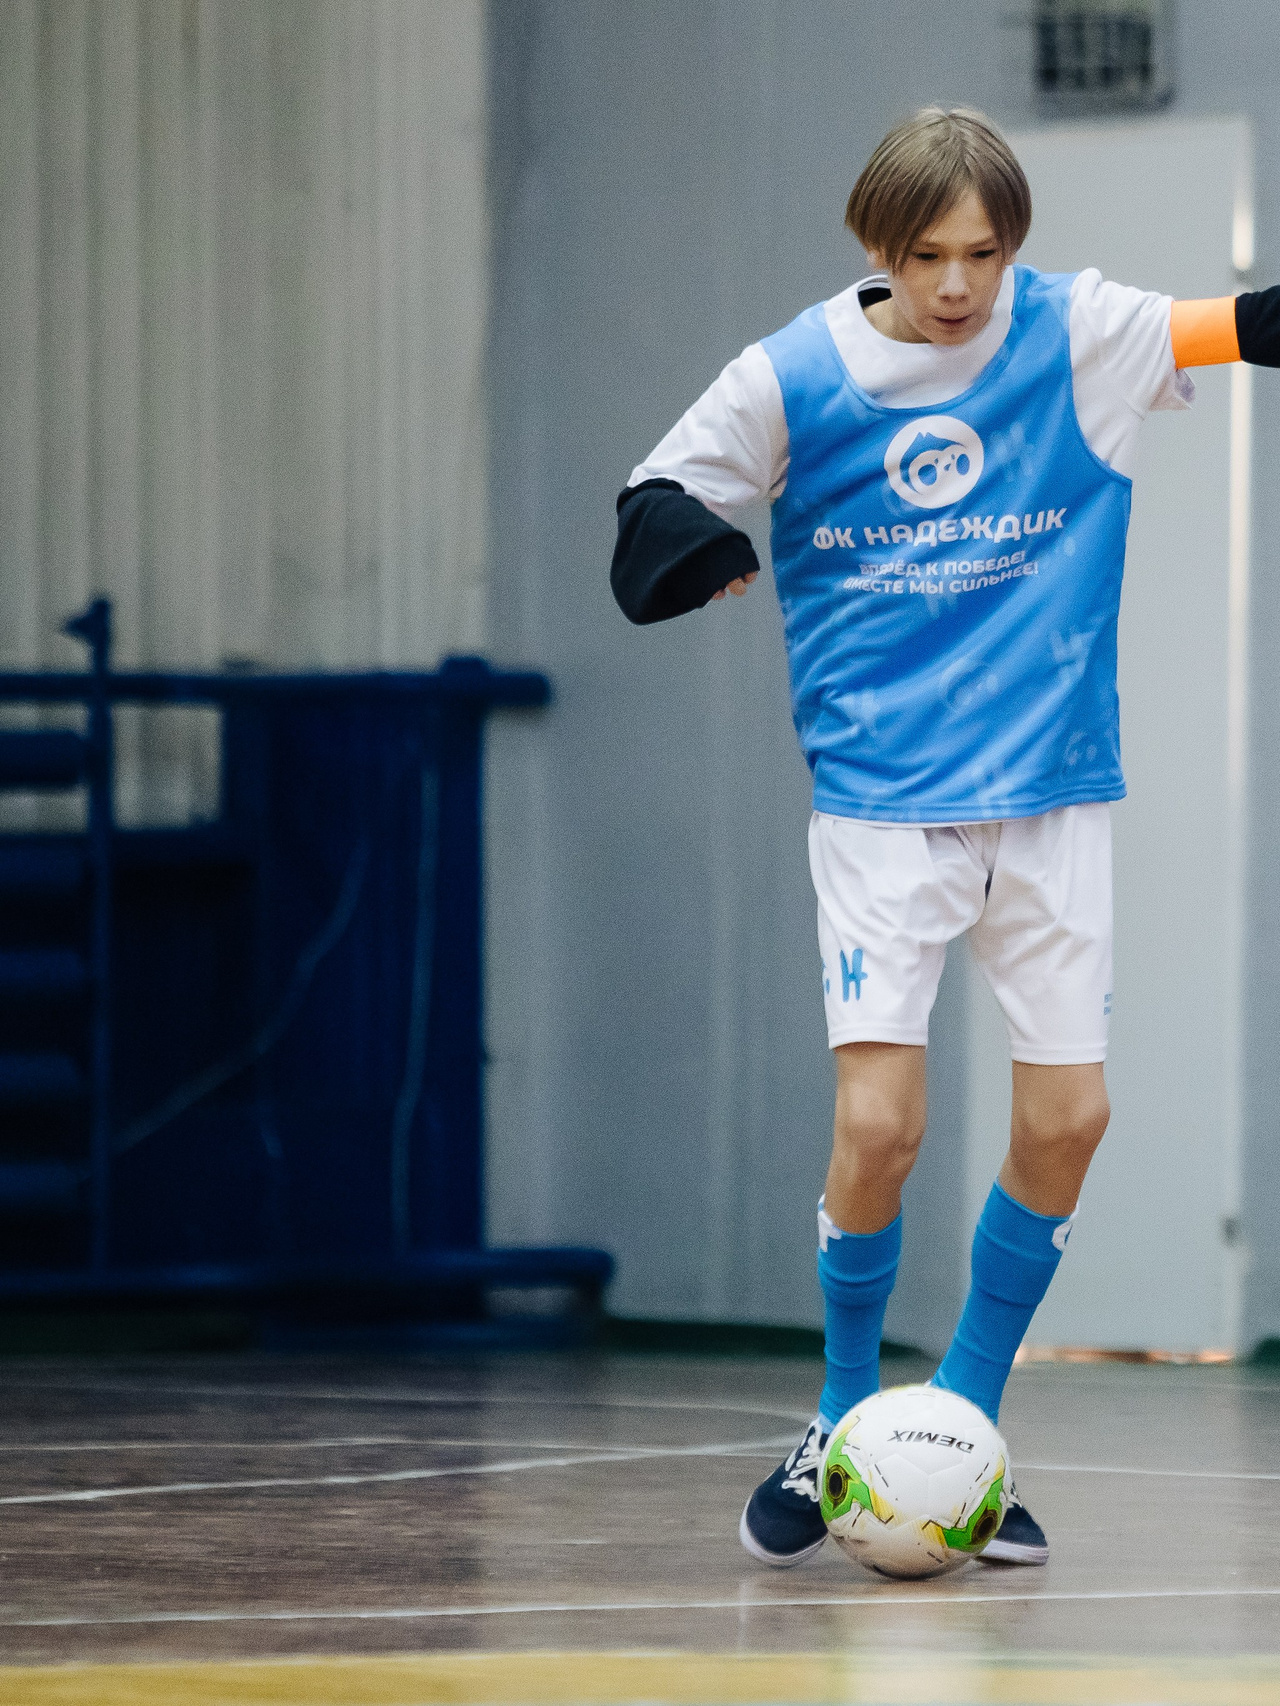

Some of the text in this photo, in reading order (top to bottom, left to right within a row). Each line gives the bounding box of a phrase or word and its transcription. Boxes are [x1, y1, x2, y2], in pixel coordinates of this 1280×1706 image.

[812, 507, 1068, 550] ФК НАДЕЖДИК
[842, 561, 1039, 595] ВМЕСТЕ МЫ СИЛЬНЕЕ!
[926, 562, 939, 576] К
[943, 550, 1026, 576] ПОБЕДЕ!
[887, 1429, 975, 1454] DEMIX
